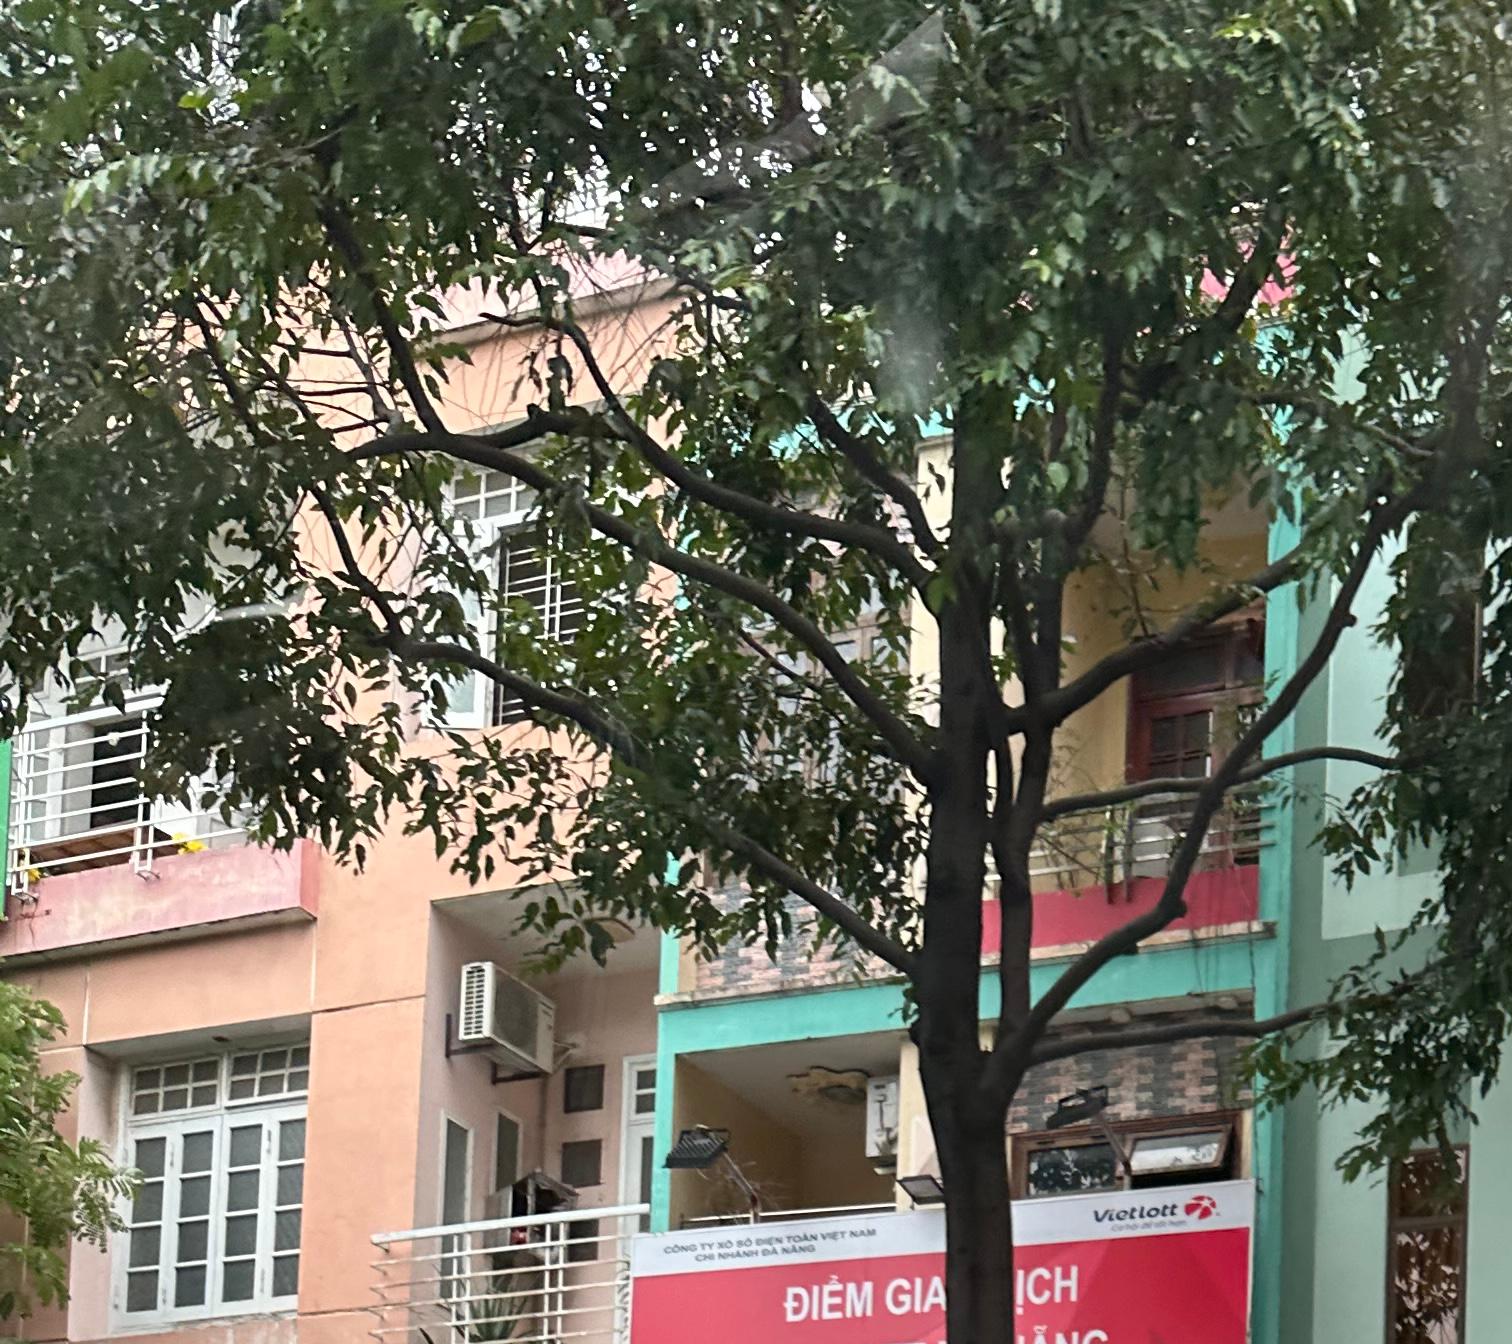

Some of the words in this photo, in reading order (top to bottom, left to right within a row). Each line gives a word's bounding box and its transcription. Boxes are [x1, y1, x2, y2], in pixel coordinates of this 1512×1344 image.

[1093, 1202, 1179, 1224] Vietlott
[700, 1242, 714, 1252] TY
[849, 1228, 877, 1239] NAM
[783, 1274, 874, 1323] ĐIỂM
[884, 1275, 947, 1315] GIA
[1015, 1265, 1079, 1316] ỊCH
